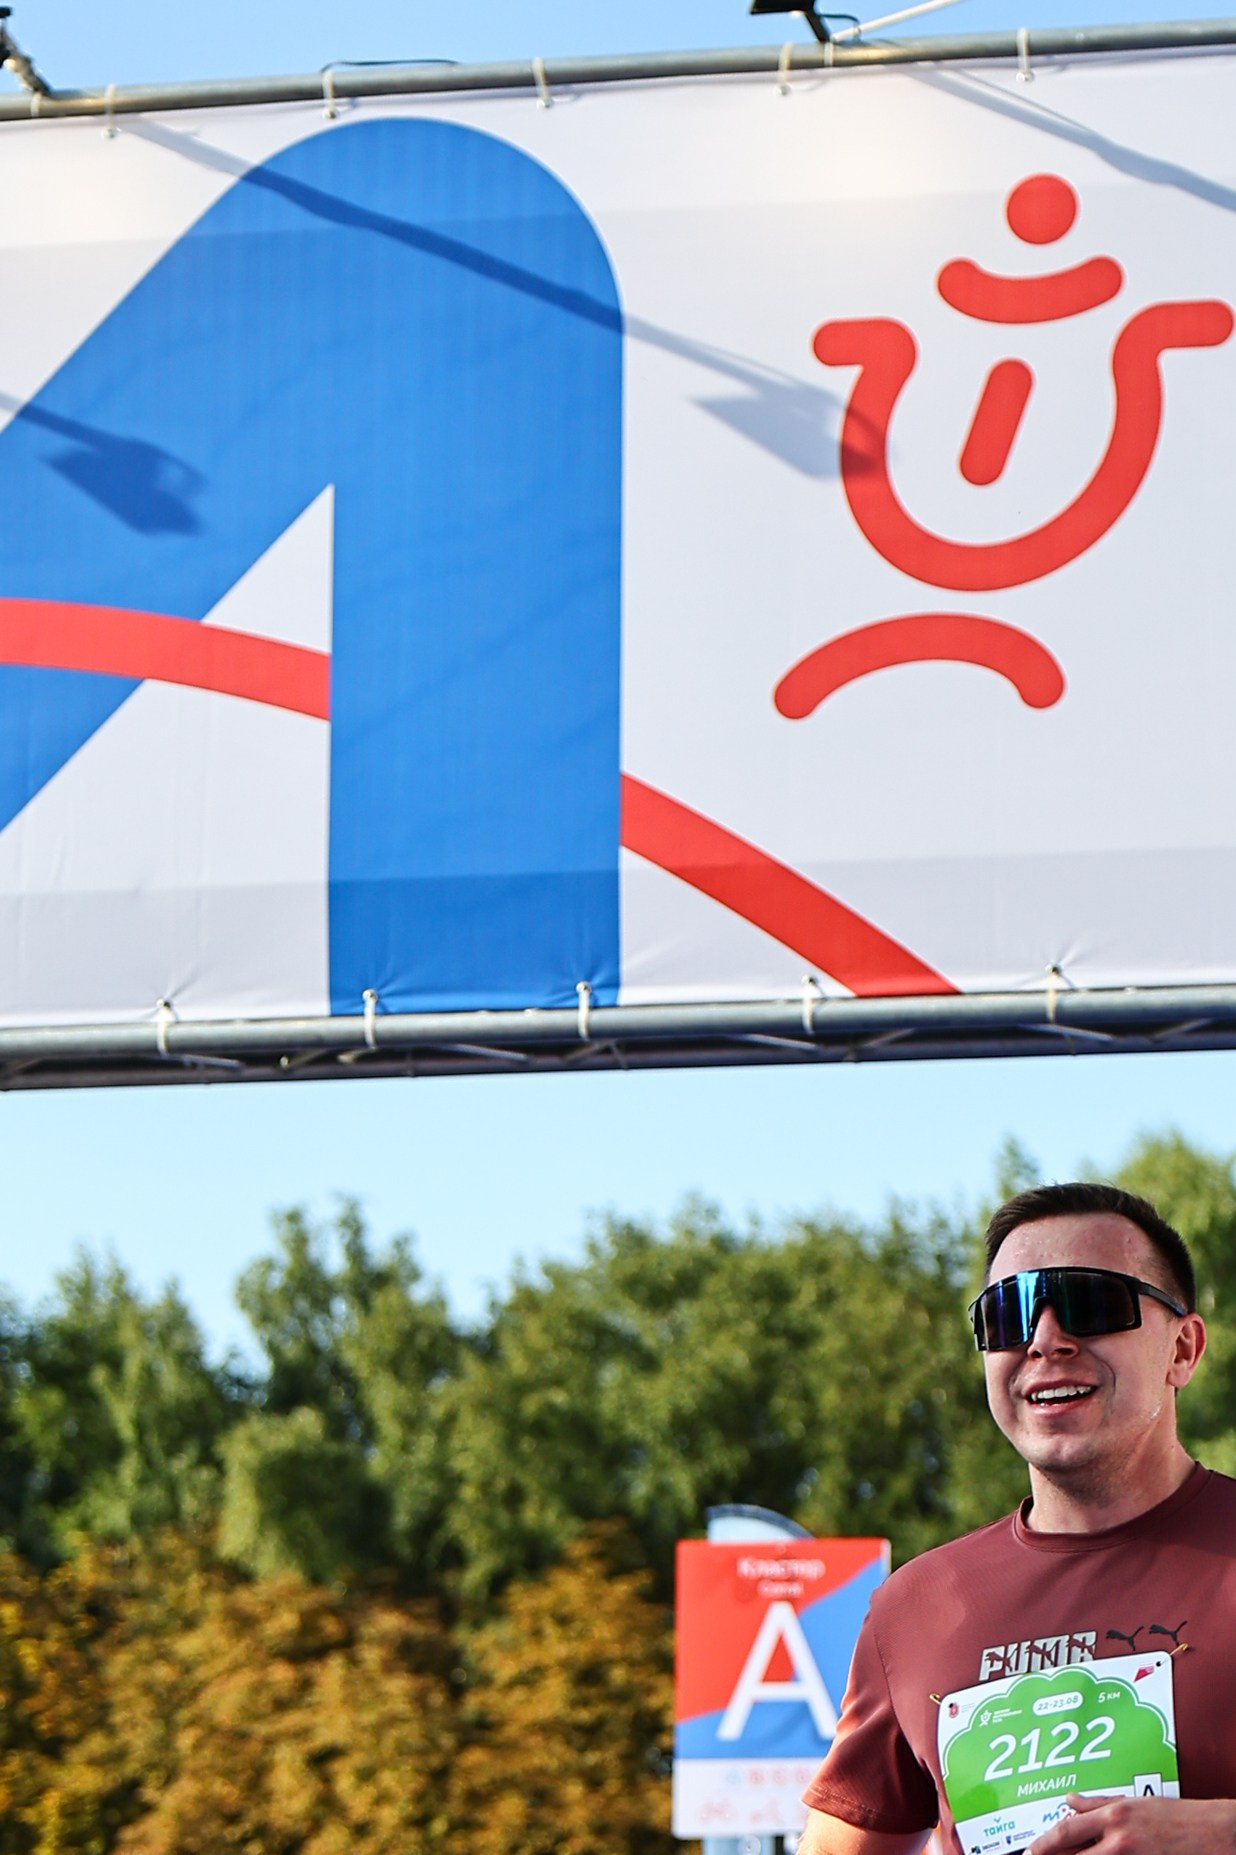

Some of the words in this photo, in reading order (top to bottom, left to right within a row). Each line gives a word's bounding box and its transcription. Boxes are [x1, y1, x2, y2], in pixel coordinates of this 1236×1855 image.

[1098, 1692, 1106, 1703] 5
[984, 1716, 1116, 1781] 2122
[1017, 1774, 1077, 1798] МИХАИЛ
[983, 1817, 1016, 1838] тайга
